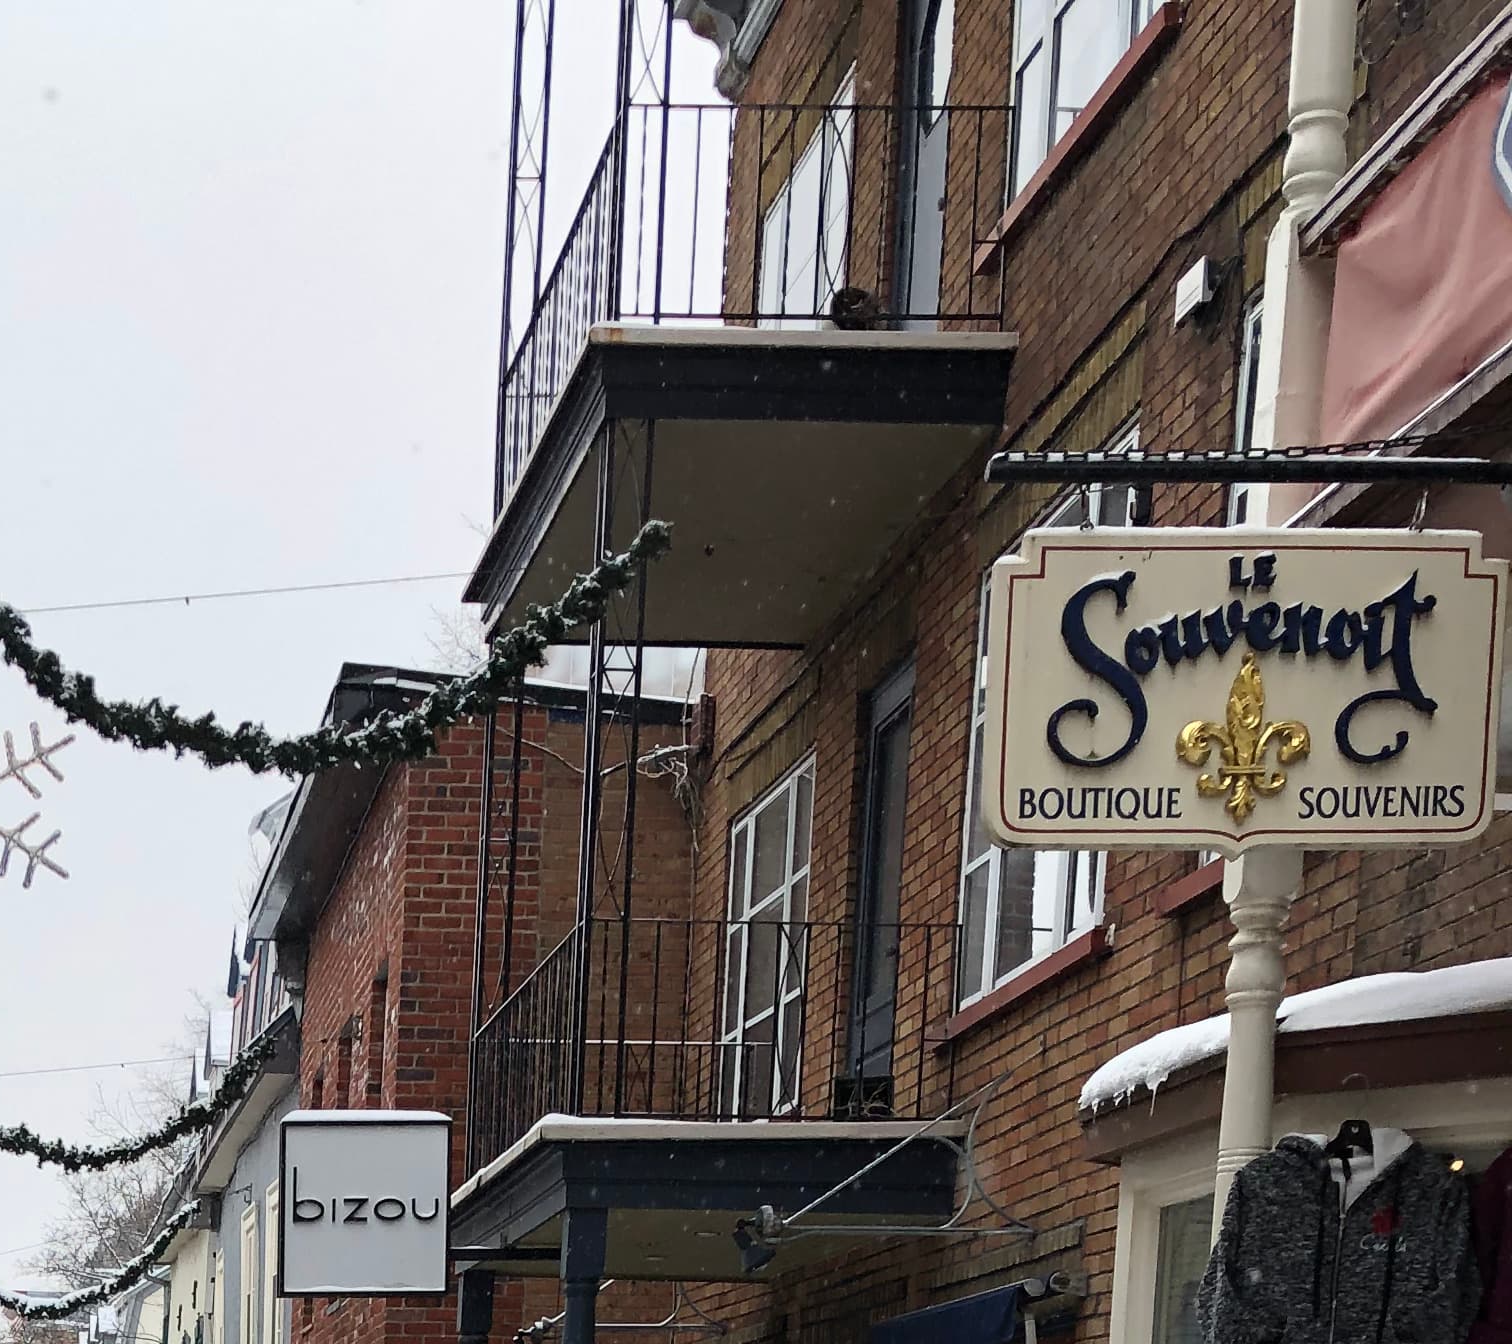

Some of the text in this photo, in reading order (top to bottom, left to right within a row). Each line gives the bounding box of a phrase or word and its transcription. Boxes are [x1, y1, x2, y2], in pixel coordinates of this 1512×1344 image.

[1228, 553, 1278, 590] LE
[1018, 785, 1466, 820] BOUTIQUE SOUVENIRS
[292, 1166, 440, 1224] bizou
